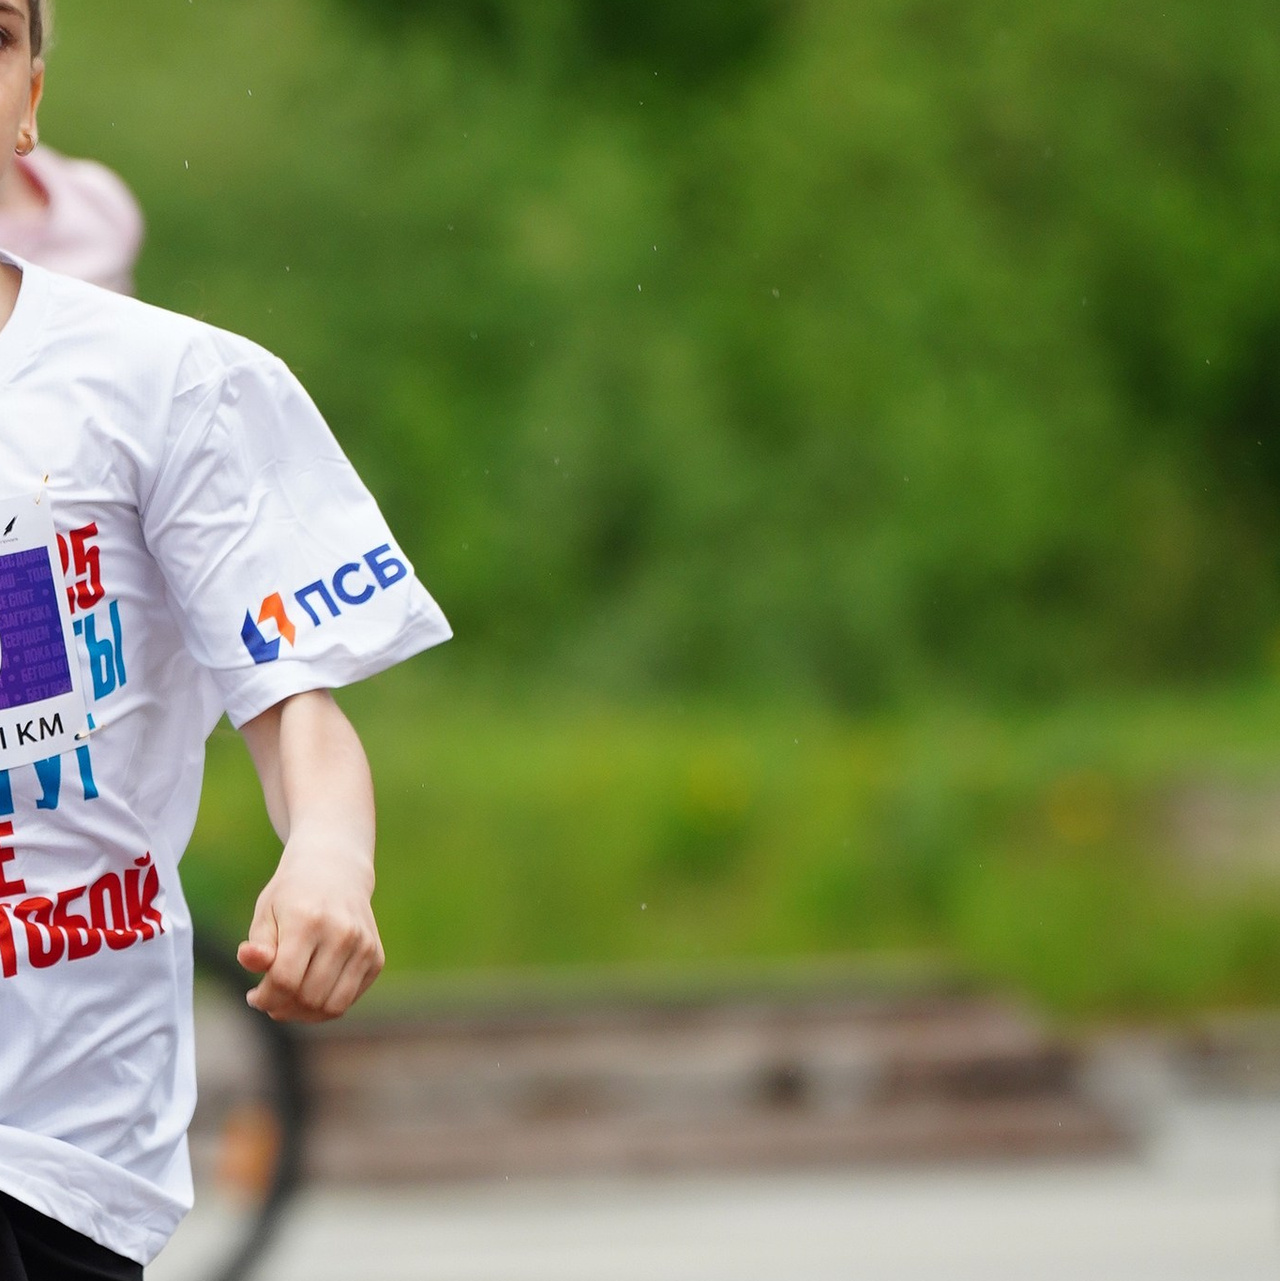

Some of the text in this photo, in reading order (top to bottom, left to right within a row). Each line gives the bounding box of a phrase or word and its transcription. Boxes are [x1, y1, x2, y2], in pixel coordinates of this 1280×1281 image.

[294, 543, 408, 627] ПСБ
[72, 599, 127, 701] Ы
[15, 712, 65, 747] КМ
